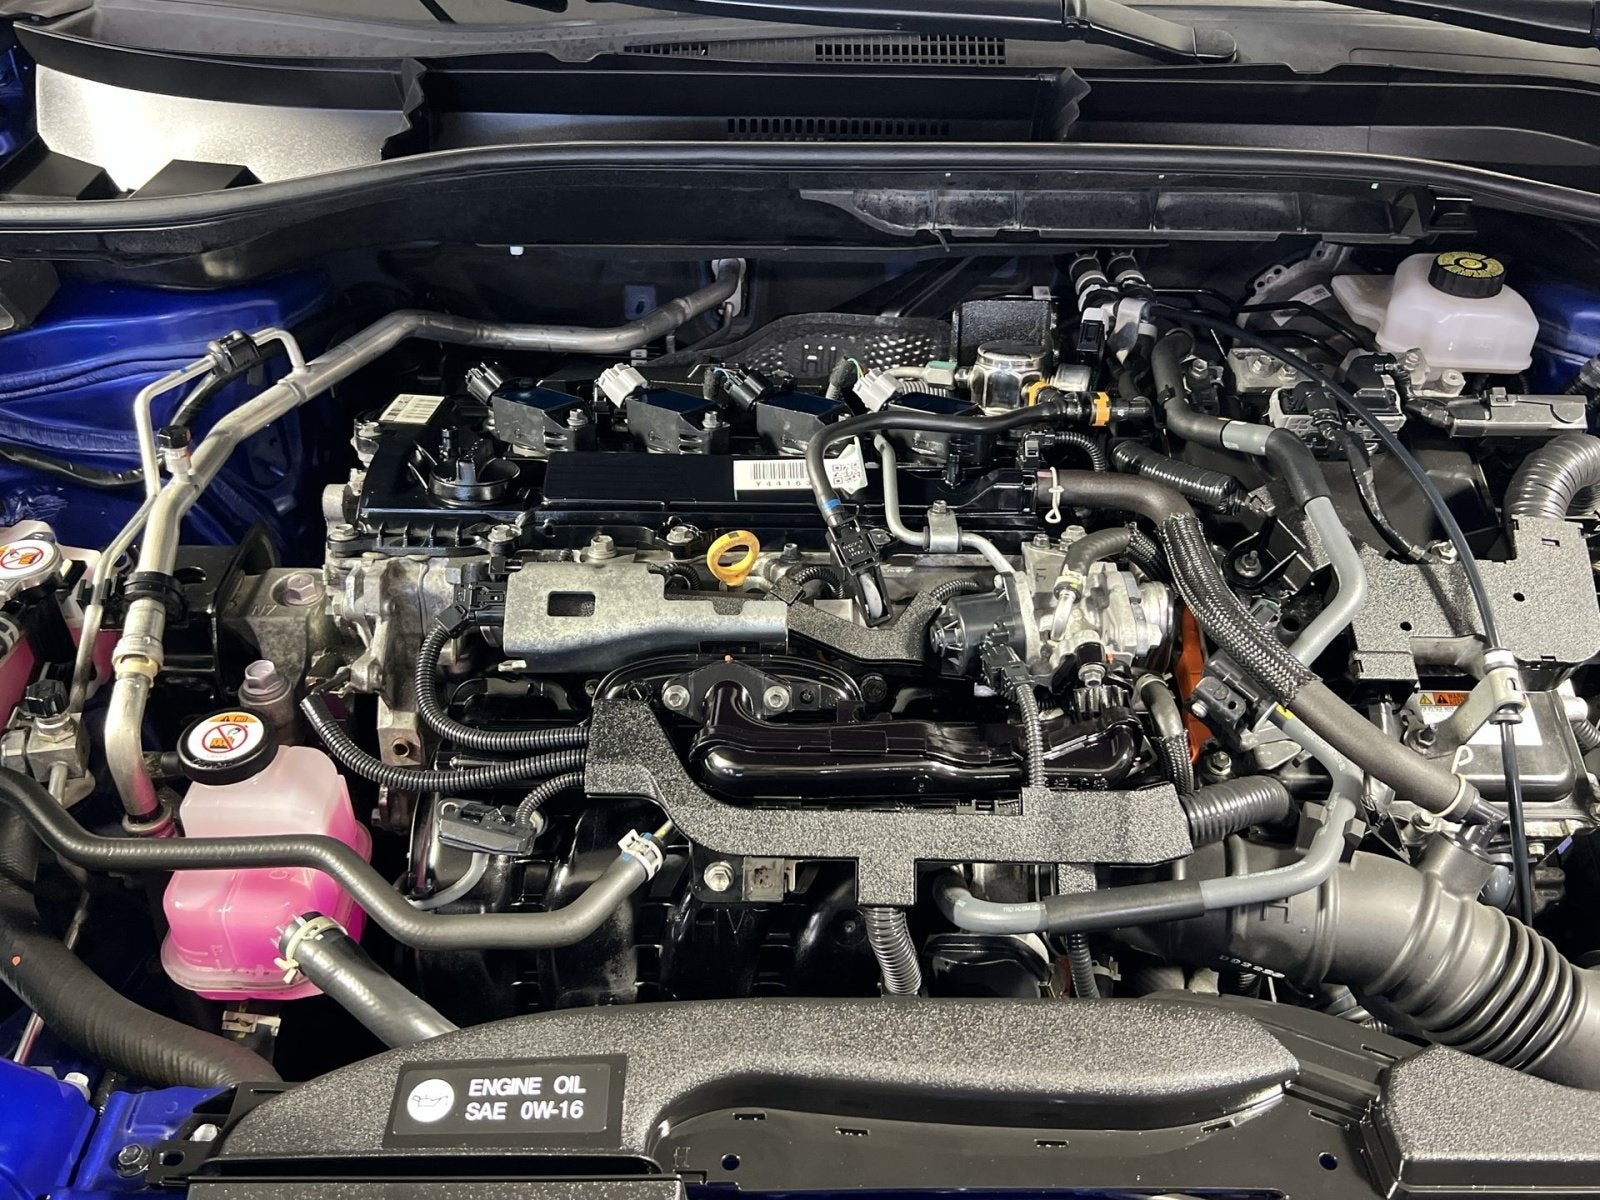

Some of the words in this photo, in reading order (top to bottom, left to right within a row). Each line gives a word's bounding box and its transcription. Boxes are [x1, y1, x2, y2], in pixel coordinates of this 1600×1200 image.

[468, 1076, 542, 1097] ENGINE
[553, 1075, 586, 1094] OIL
[464, 1102, 507, 1121] SAE
[520, 1100, 584, 1120] 0W-16
